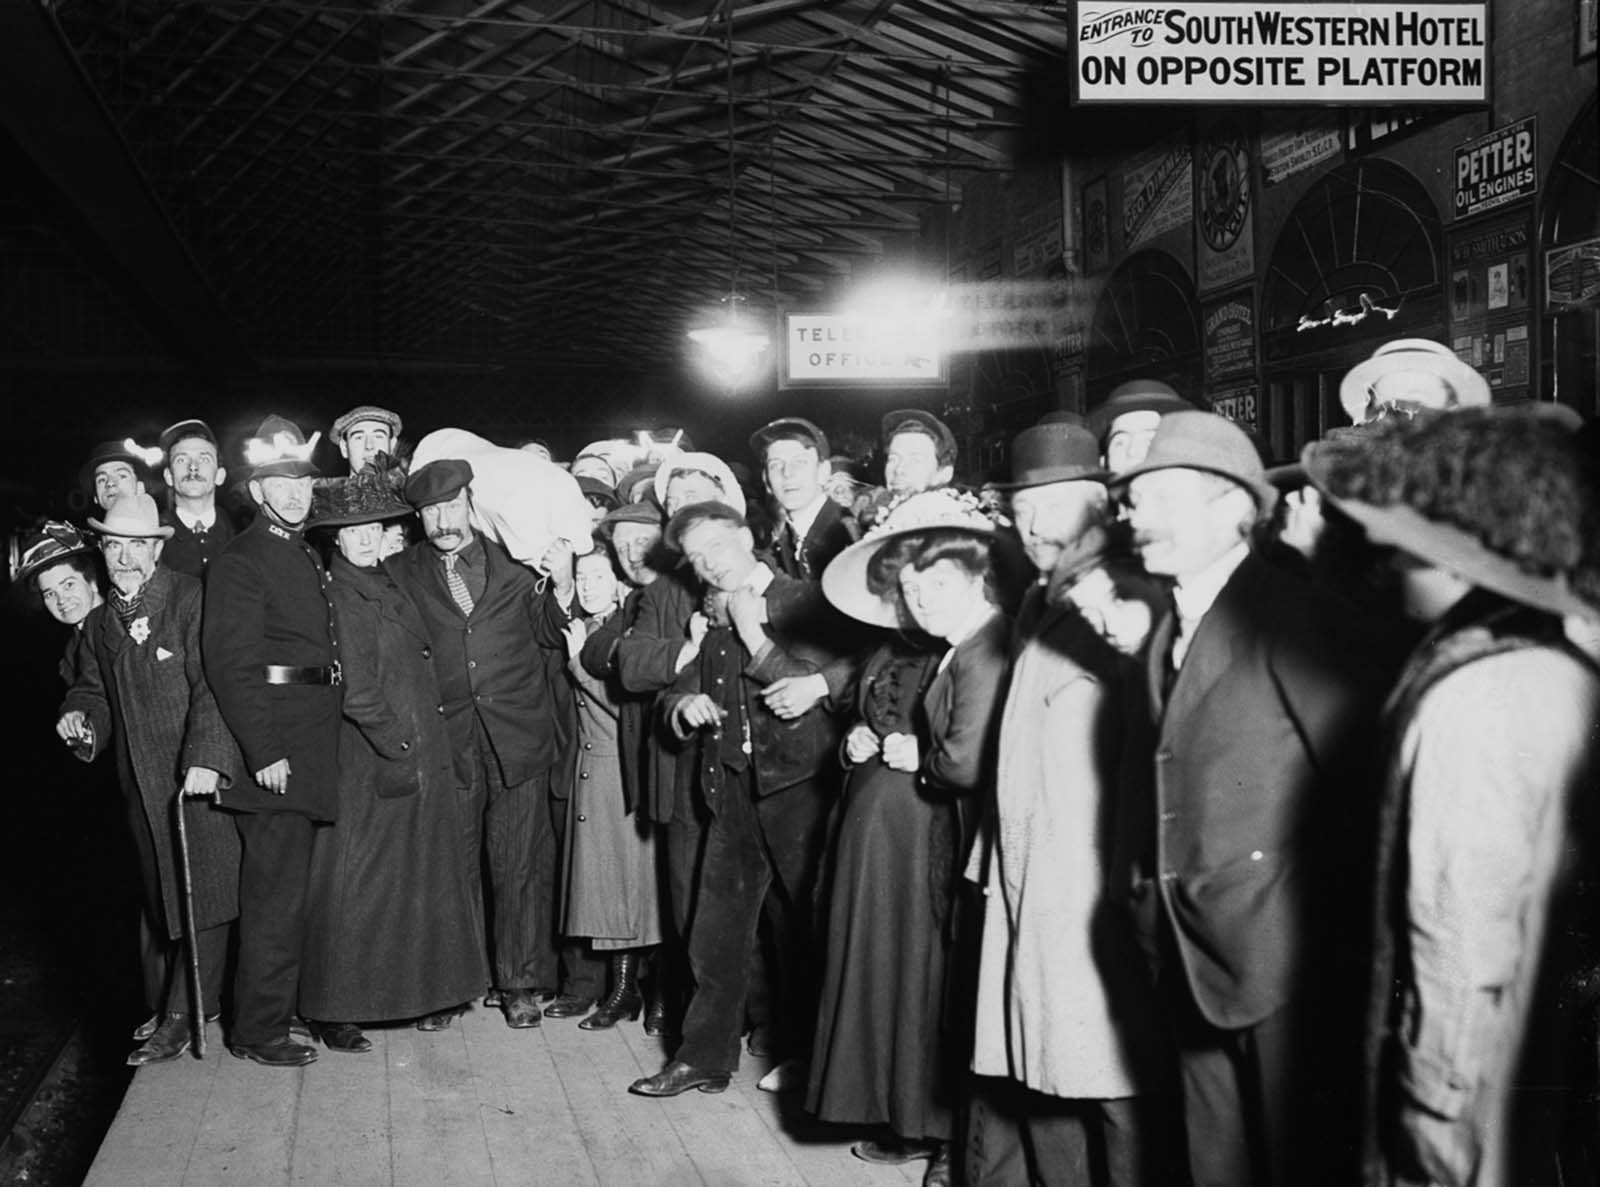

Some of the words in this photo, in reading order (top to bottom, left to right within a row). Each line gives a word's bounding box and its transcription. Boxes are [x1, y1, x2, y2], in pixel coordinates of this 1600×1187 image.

[1080, 9, 1165, 41] ENTRANCE
[1131, 27, 1154, 43] TO
[1396, 11, 1484, 46] HOTEL
[1081, 56, 1126, 85] ON
[1137, 57, 1305, 86] OPPOSITE
[1317, 57, 1481, 86] PLATFORM
[1458, 131, 1532, 189] PETTER
[1456, 190, 1476, 207] OIL
[1479, 168, 1534, 200] ENGINES
